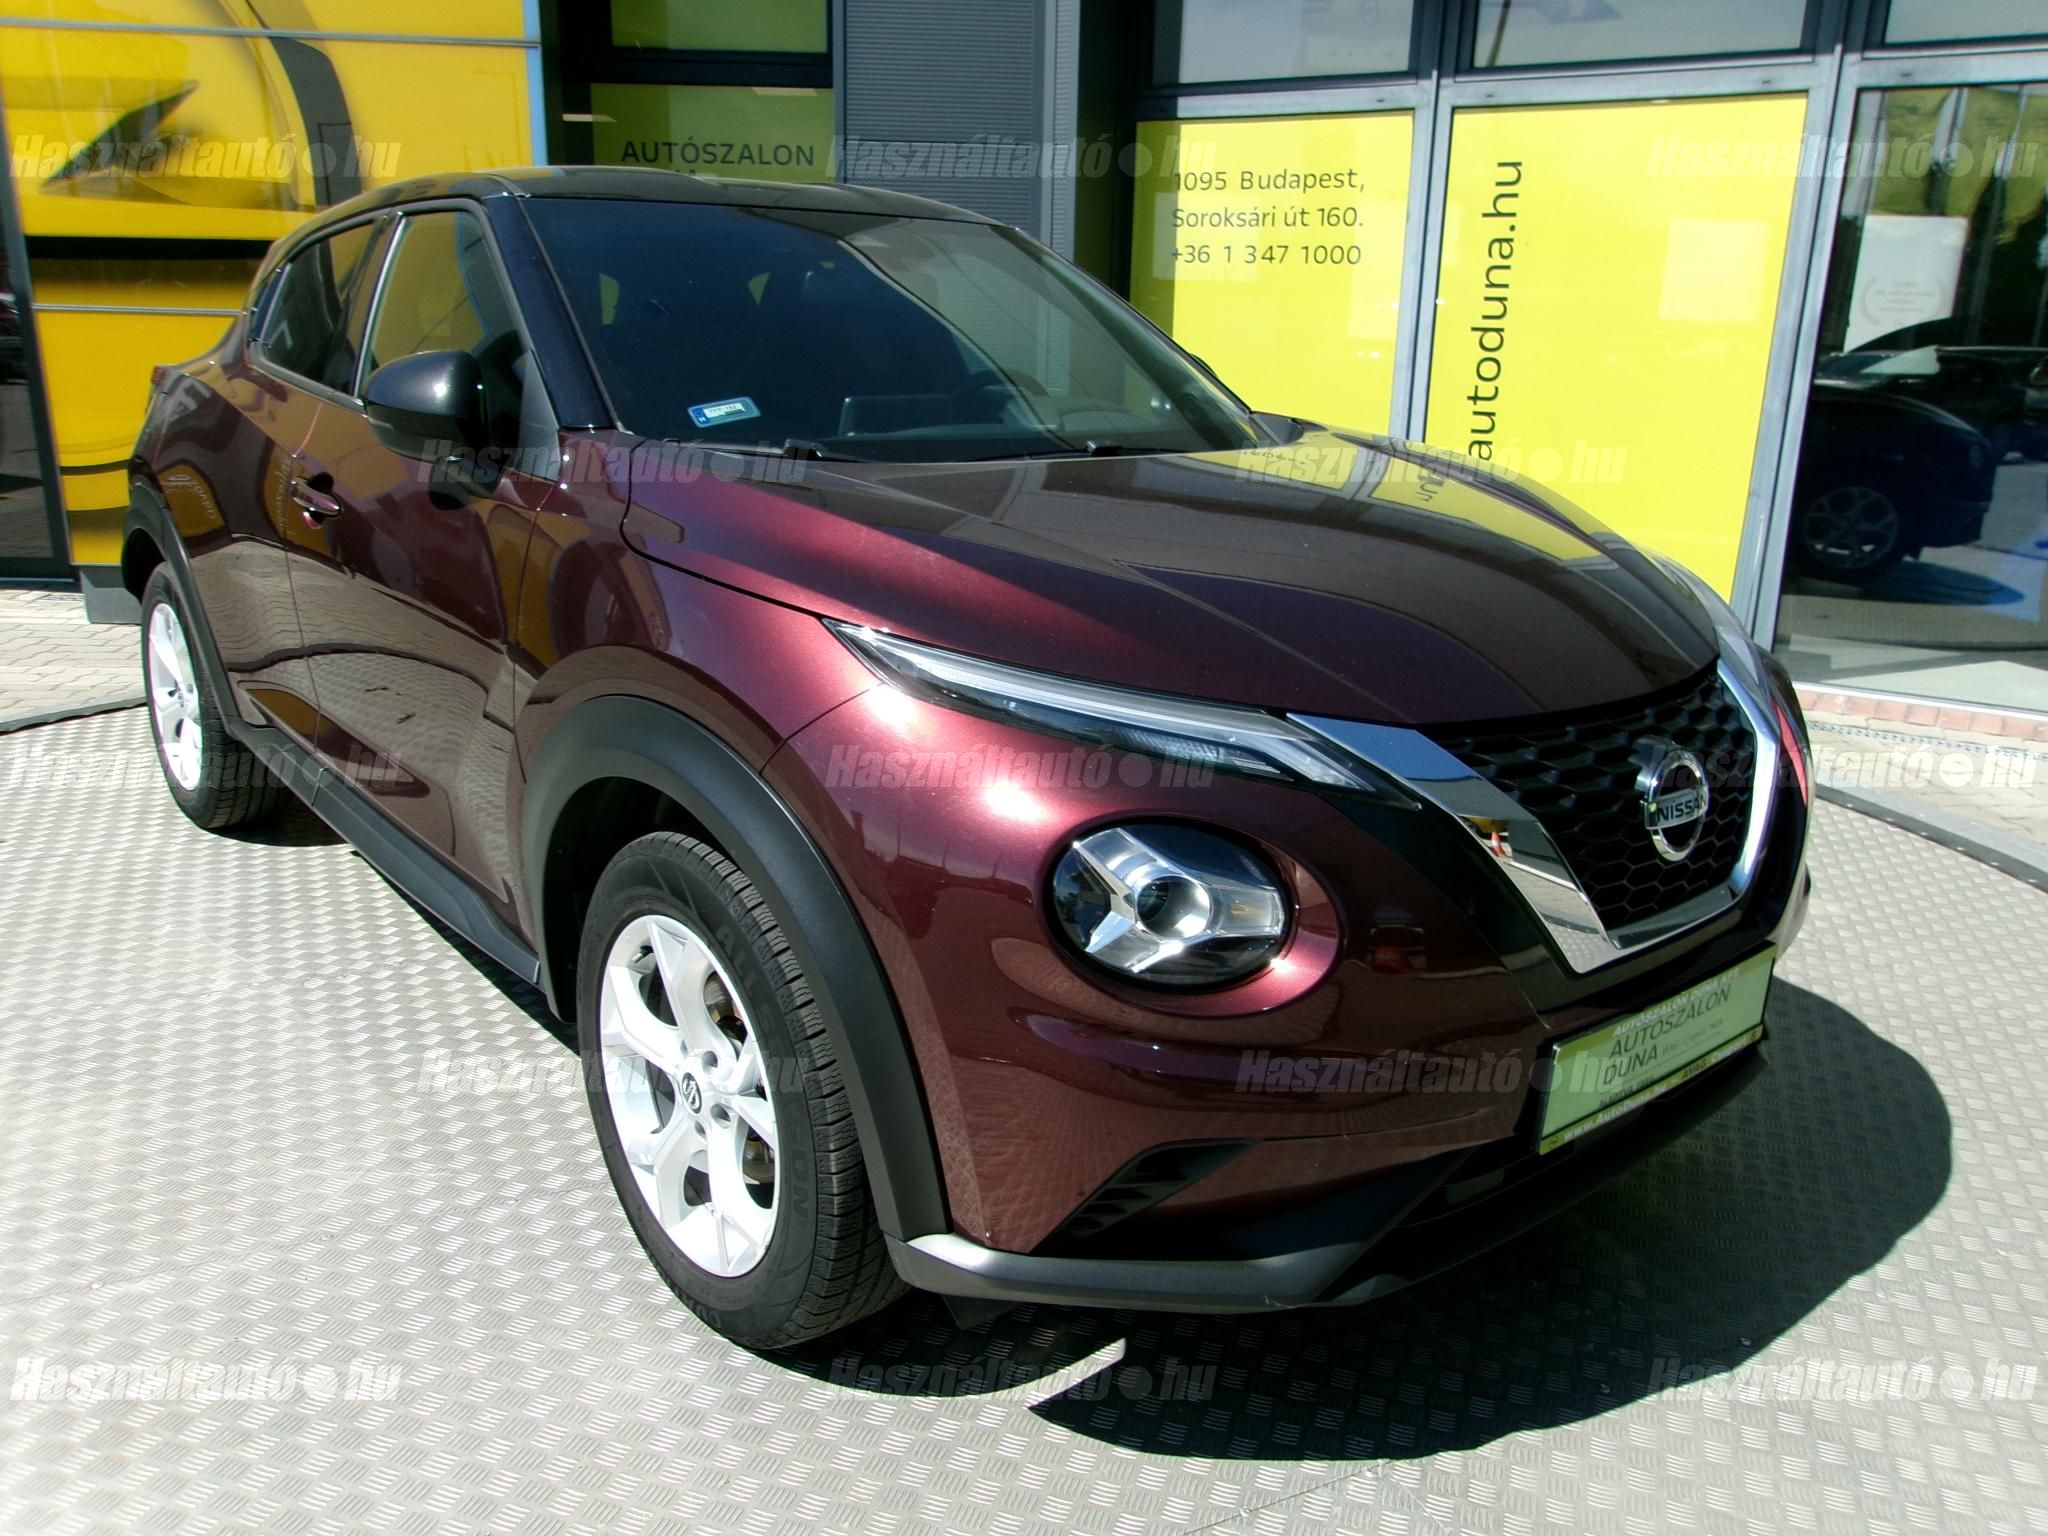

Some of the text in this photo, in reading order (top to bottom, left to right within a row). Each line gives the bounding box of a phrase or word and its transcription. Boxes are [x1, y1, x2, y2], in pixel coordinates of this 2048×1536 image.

[621, 136, 815, 166] AUTÓSZALON
[1174, 168, 1364, 193] 1095 Budapest,
[1172, 206, 1364, 228] Soroksári út 160.
[1171, 244, 1211, 264] +36
[1223, 245, 1232, 264] 1
[1301, 244, 1361, 265] 1000
[1467, 161, 1523, 461] autoduna.hu
[1657, 797, 1700, 822] NISSA
[1603, 1043, 1657, 1085] DUNA
